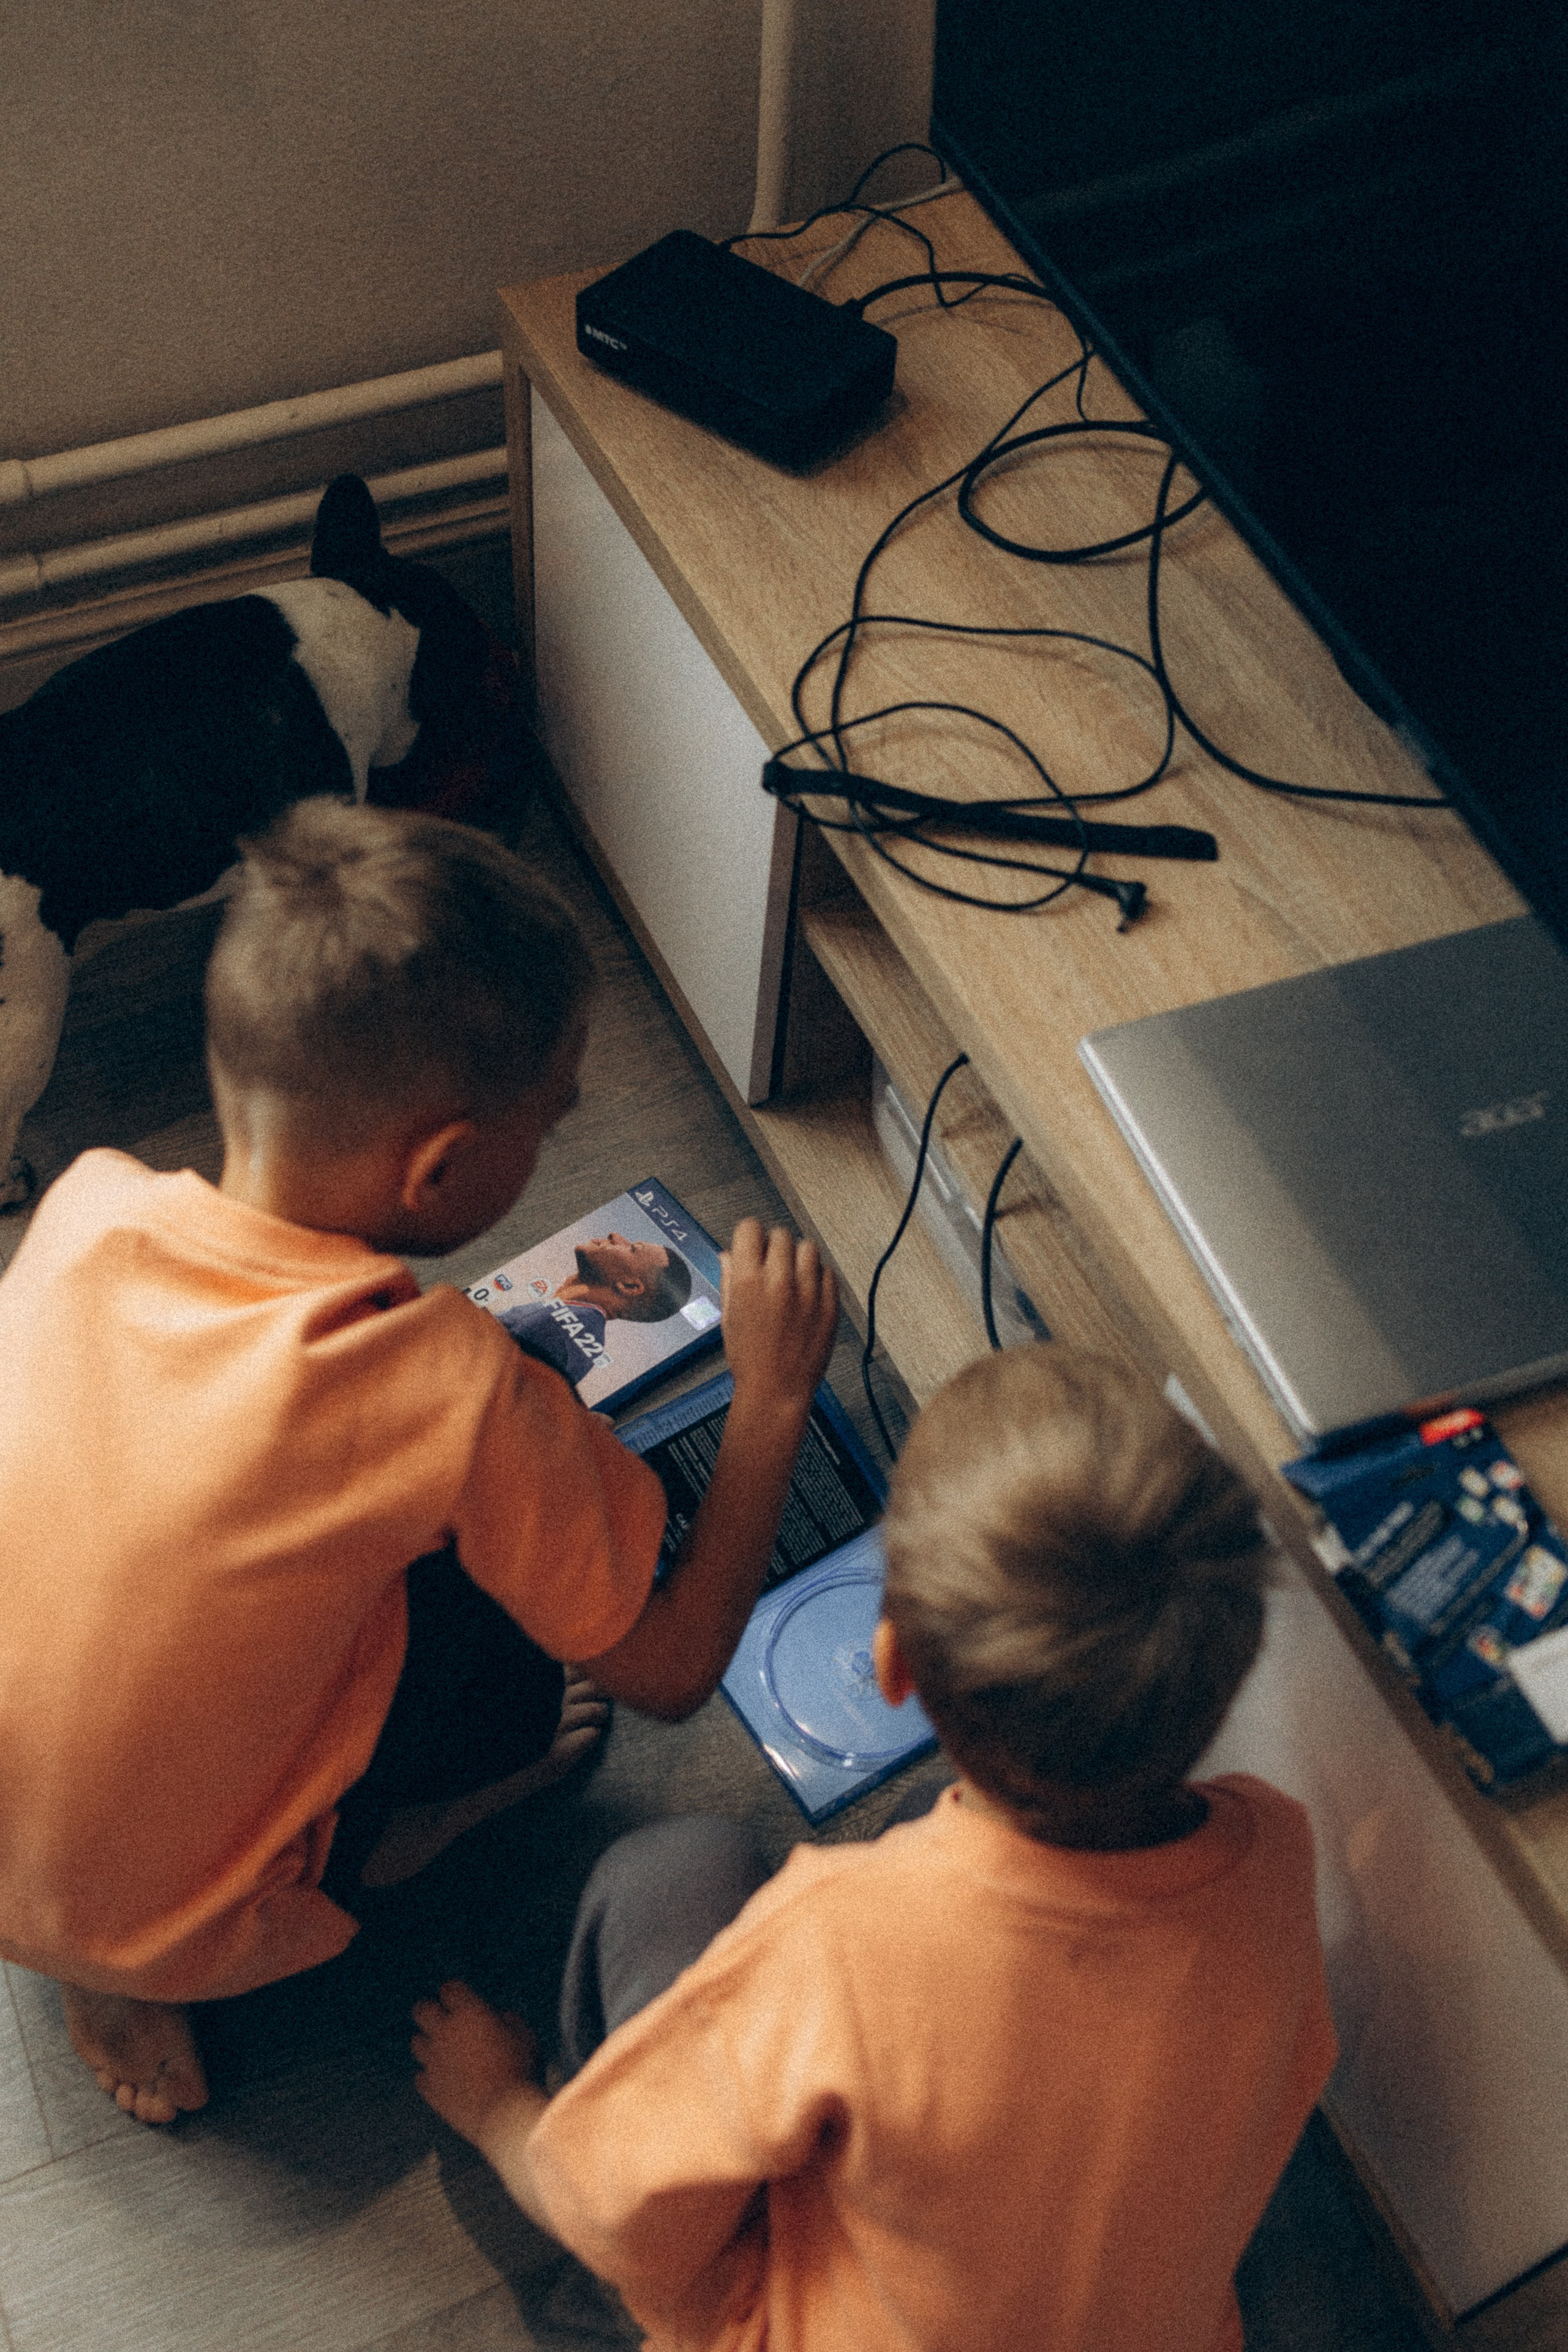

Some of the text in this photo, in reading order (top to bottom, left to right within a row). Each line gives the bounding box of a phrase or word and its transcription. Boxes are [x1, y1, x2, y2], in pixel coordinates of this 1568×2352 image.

[652, 1205, 687, 1241] PS4
[543, 1297, 585, 1338] FIFA
[573, 1330, 604, 1358] 22
